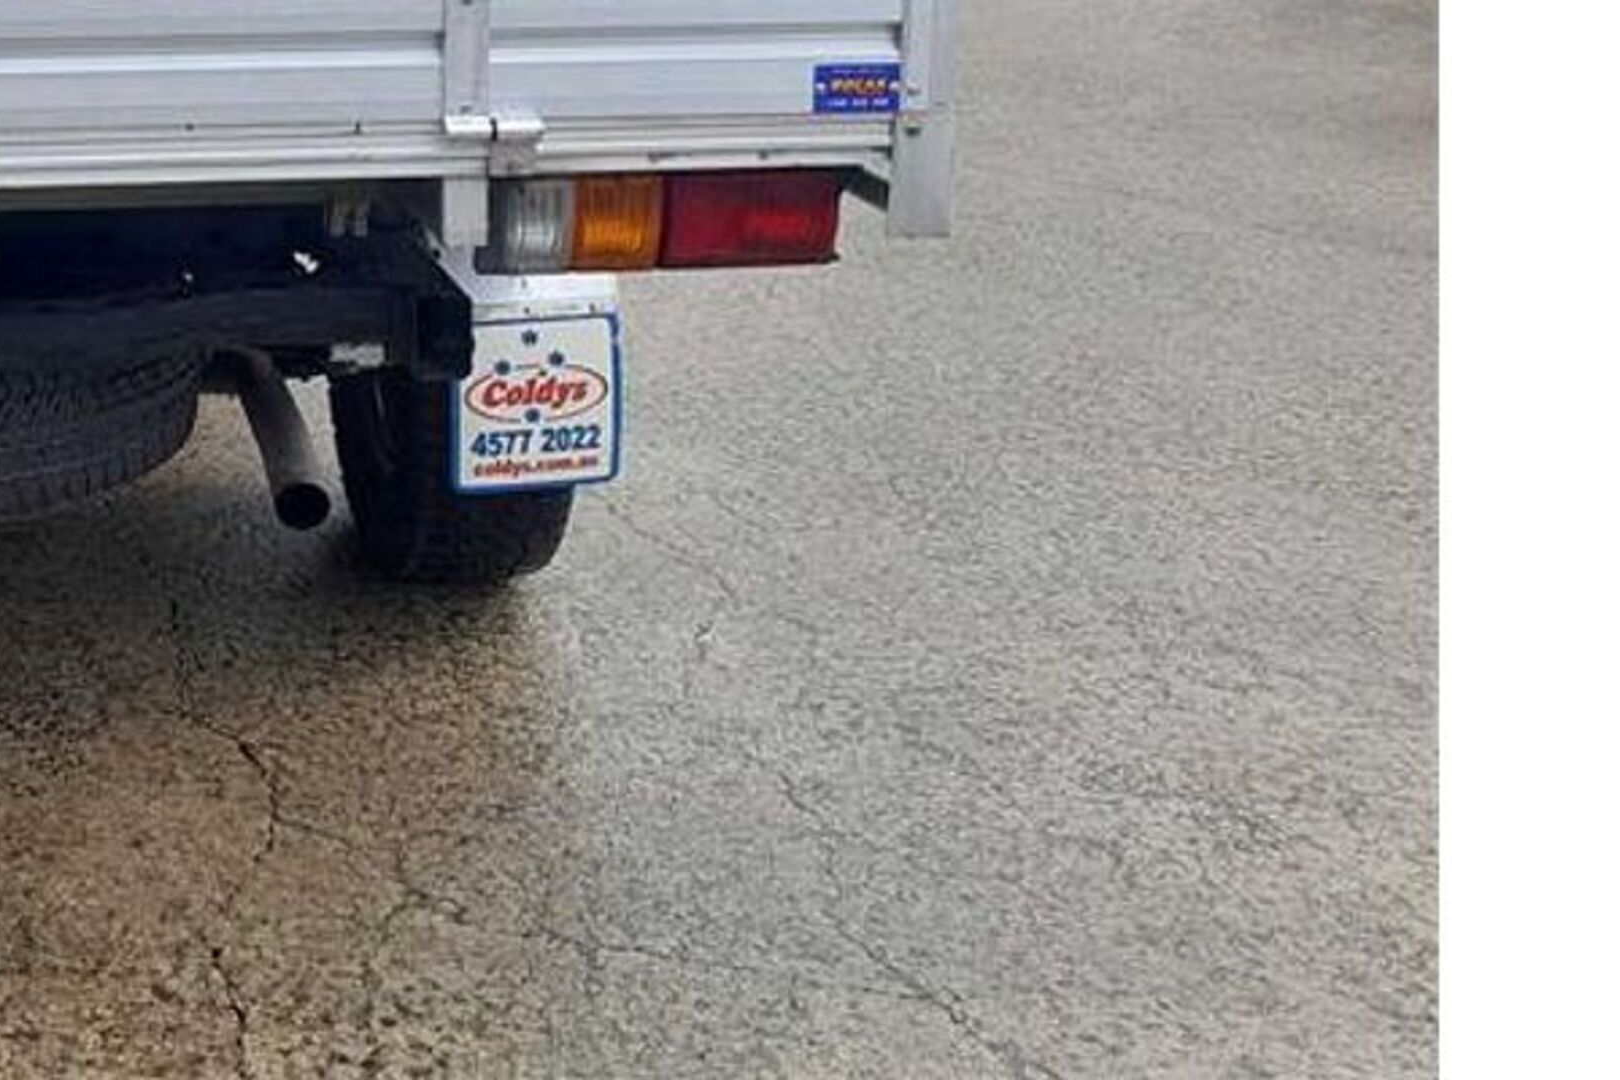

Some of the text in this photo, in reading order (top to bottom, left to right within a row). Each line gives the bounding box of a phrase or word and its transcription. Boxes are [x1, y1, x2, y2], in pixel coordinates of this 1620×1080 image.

[483, 378, 588, 408] Coldys
[470, 424, 601, 457] 4577 2022
[473, 456, 599, 478] coldys.com.au
